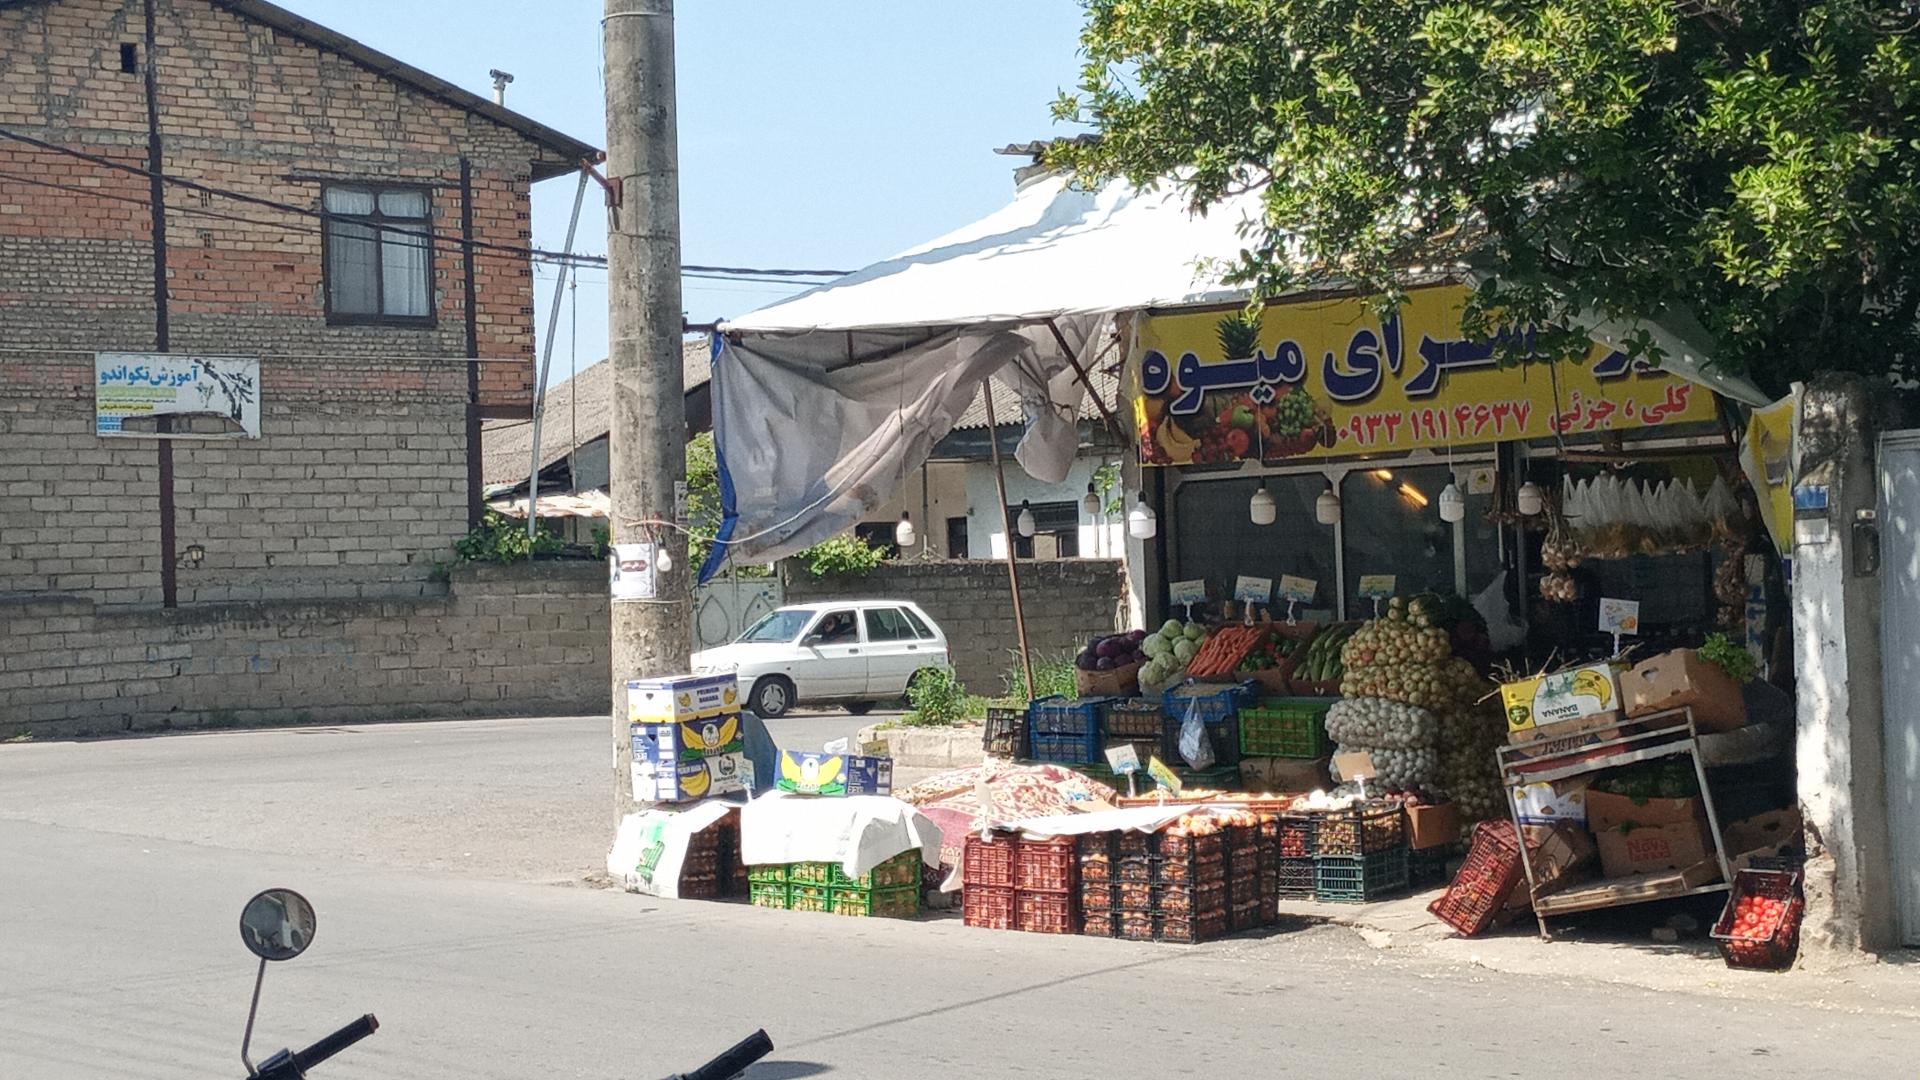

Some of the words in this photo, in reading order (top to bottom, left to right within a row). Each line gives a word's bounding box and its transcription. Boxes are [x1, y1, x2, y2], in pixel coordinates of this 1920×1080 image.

[100, 365, 149, 386] تکواندو
[150, 365, 199, 387] آموزش
[1141, 339, 1306, 415] میوه
[1641, 383, 1692, 425] کلی
[1541, 703, 1579, 718] BANANA
